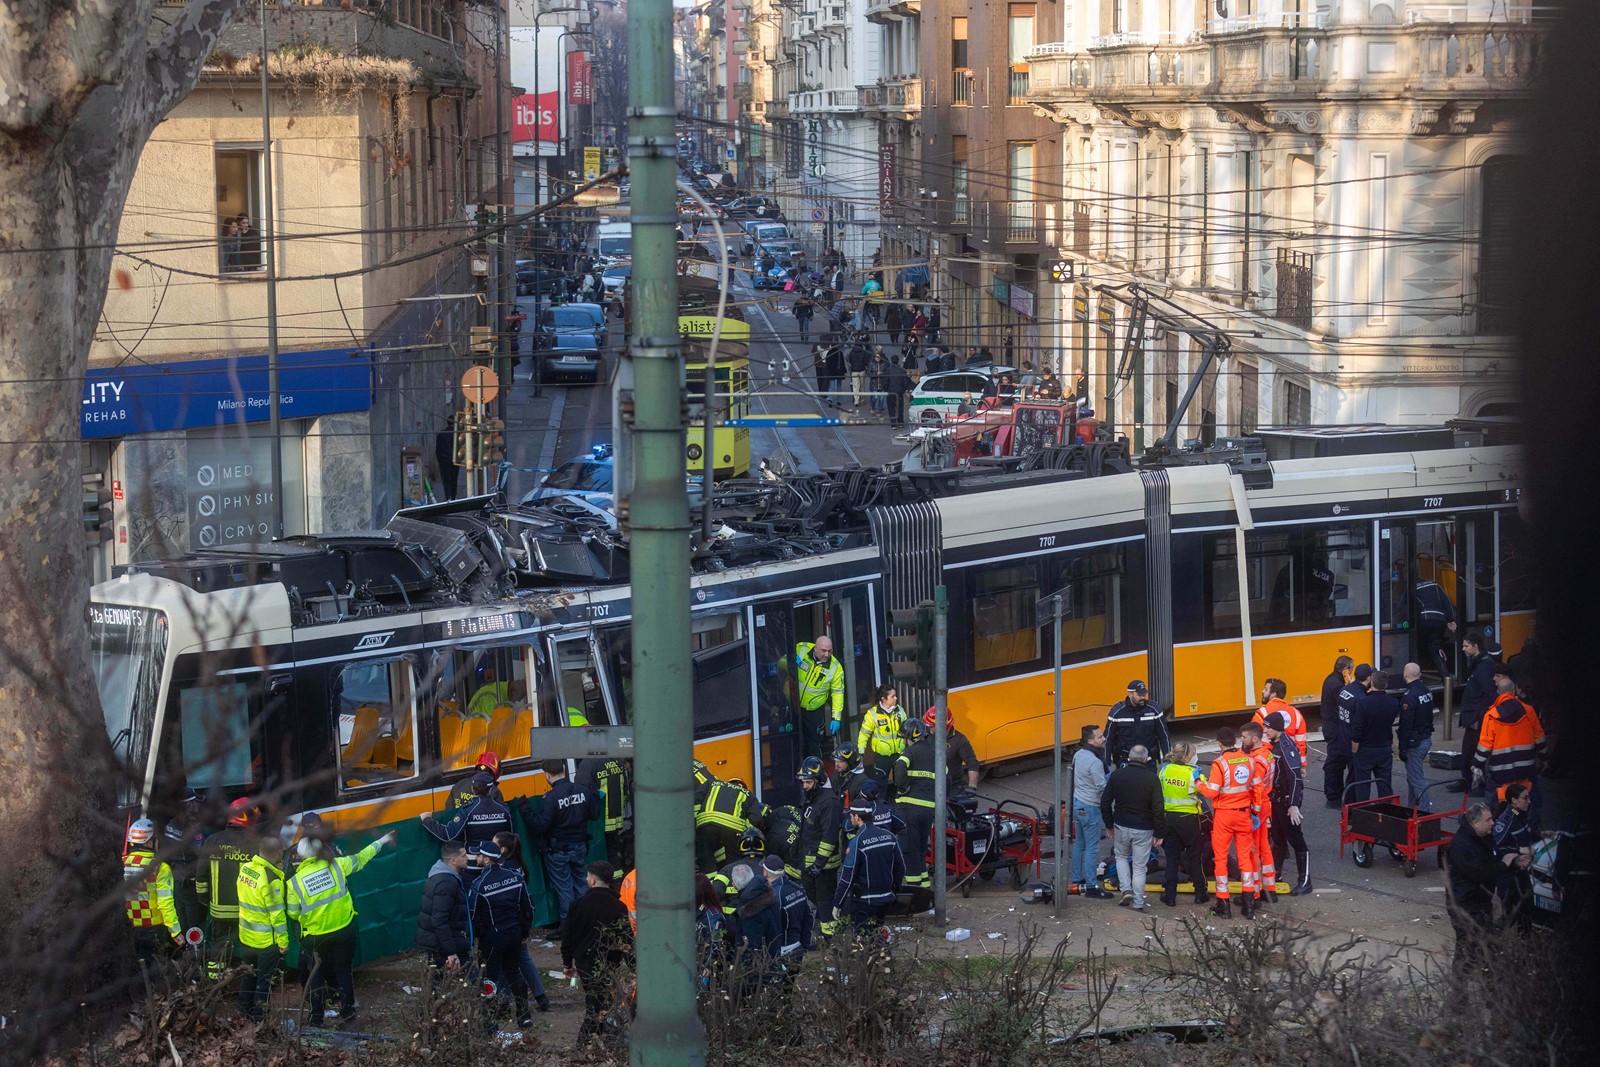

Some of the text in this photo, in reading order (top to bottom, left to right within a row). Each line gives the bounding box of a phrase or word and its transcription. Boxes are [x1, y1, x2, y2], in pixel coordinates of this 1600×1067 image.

[572, 81, 583, 98] ibis
[516, 105, 553, 125] ibis
[883, 152, 892, 208] BRIANZA
[218, 400, 246, 410] Milano
[85, 410, 127, 423] REHAB
[223, 465, 253, 479] MED
[1423, 497, 1443, 507] 7707
[225, 522, 268, 539] CRYO
[1039, 535, 1056, 547] 7707
[104, 607, 131, 626] GENOVA
[132, 609, 143, 626] FS
[586, 604, 609, 617] 7707
[364, 636, 384, 646] ATM
[597, 769, 610, 779] DEL
[472, 812, 505, 821] POLIZIA LOCALE
[862, 837, 878, 846] POLIZIA
[305, 871, 329, 884] DIRETTORE
[307, 876, 331, 888] SOCCORSI
[484, 876, 518, 891] POLIZIA LOCALE
[309, 880, 333, 892] SANITARI
